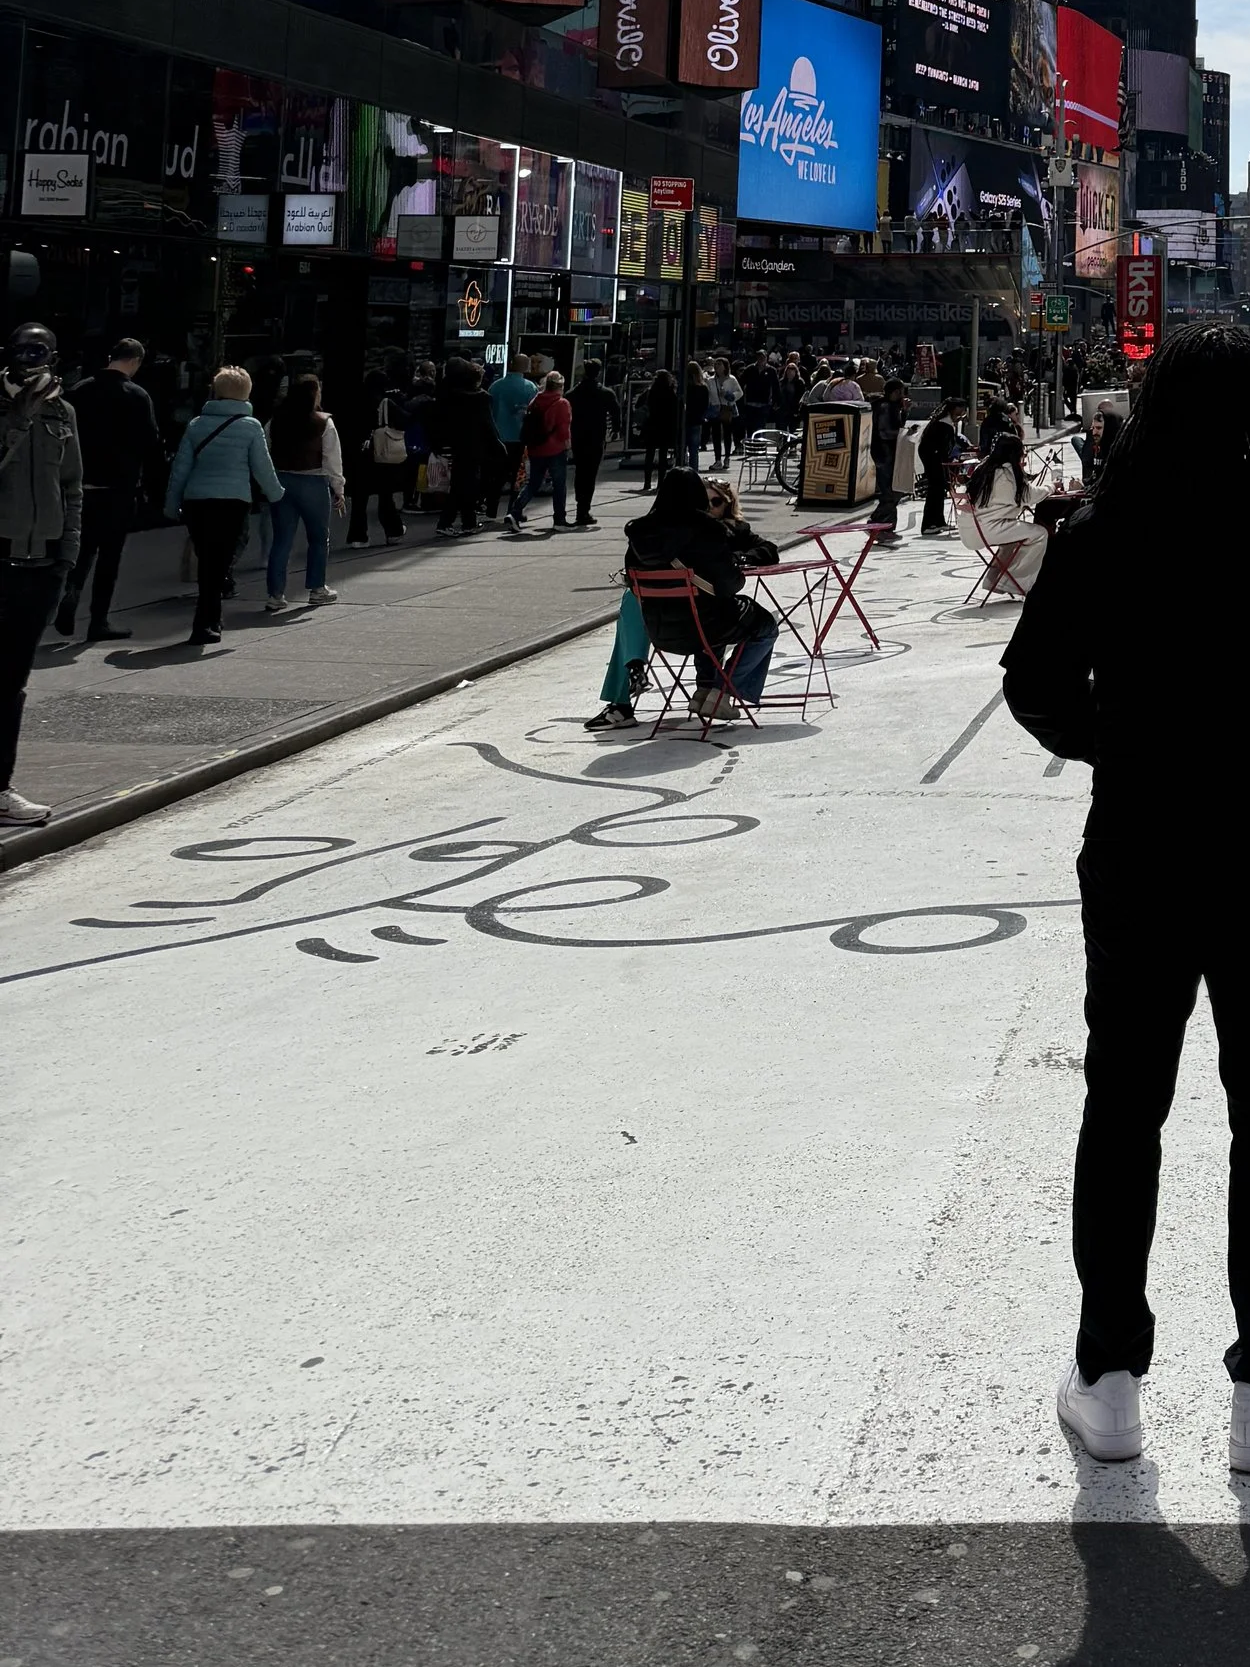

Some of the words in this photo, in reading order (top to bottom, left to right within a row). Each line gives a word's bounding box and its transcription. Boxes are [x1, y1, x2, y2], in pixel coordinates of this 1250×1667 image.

[759, 85, 839, 166] Angeles
[27, 168, 57, 193] Happy
[661, 180, 687, 189] STOPPING
[797, 159, 809, 180] WE
[809, 161, 827, 183] LOVE
[827, 164, 837, 185] LA
[1179, 160, 1187, 192] 1500
[653, 187, 675, 196] Anytime
[979, 190, 998, 208] Galaxy
[1006, 195, 1022, 209] Series
[1079, 181, 1117, 234] WICKED
[285, 222, 316, 233] Arabian
[316, 221, 333, 233] Oud
[741, 257, 761, 272] Olive
[760, 260, 796, 275] Garden
[1128, 259, 1156, 318] tkts
